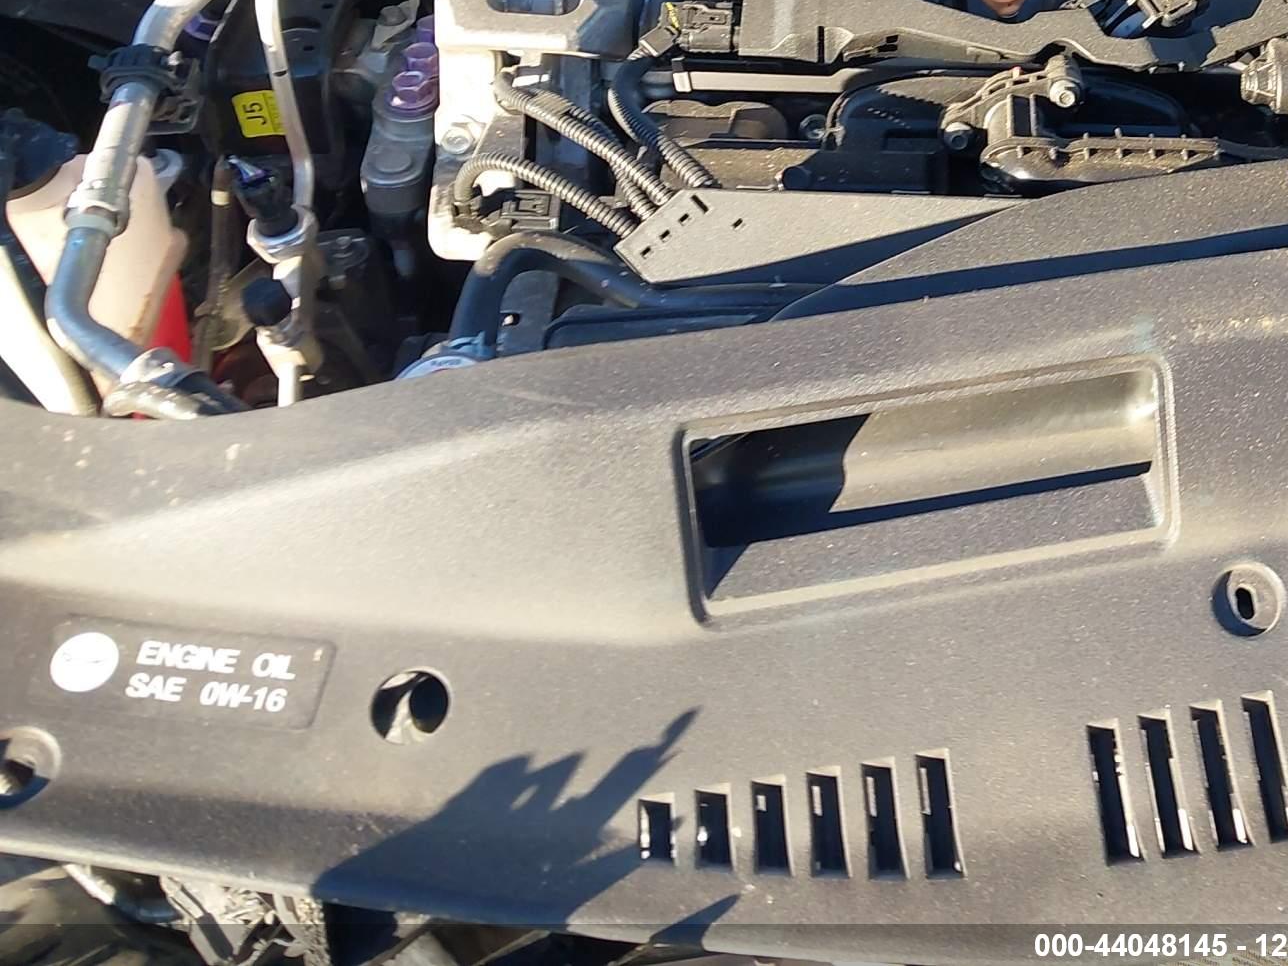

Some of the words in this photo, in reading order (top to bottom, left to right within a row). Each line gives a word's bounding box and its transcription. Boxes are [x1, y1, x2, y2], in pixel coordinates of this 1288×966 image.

[242, 102, 267, 126] J5
[136, 640, 241, 674] ENGINE
[251, 652, 297, 680] OIL
[125, 672, 185, 702] SAE
[199, 681, 288, 713] 0W-16
